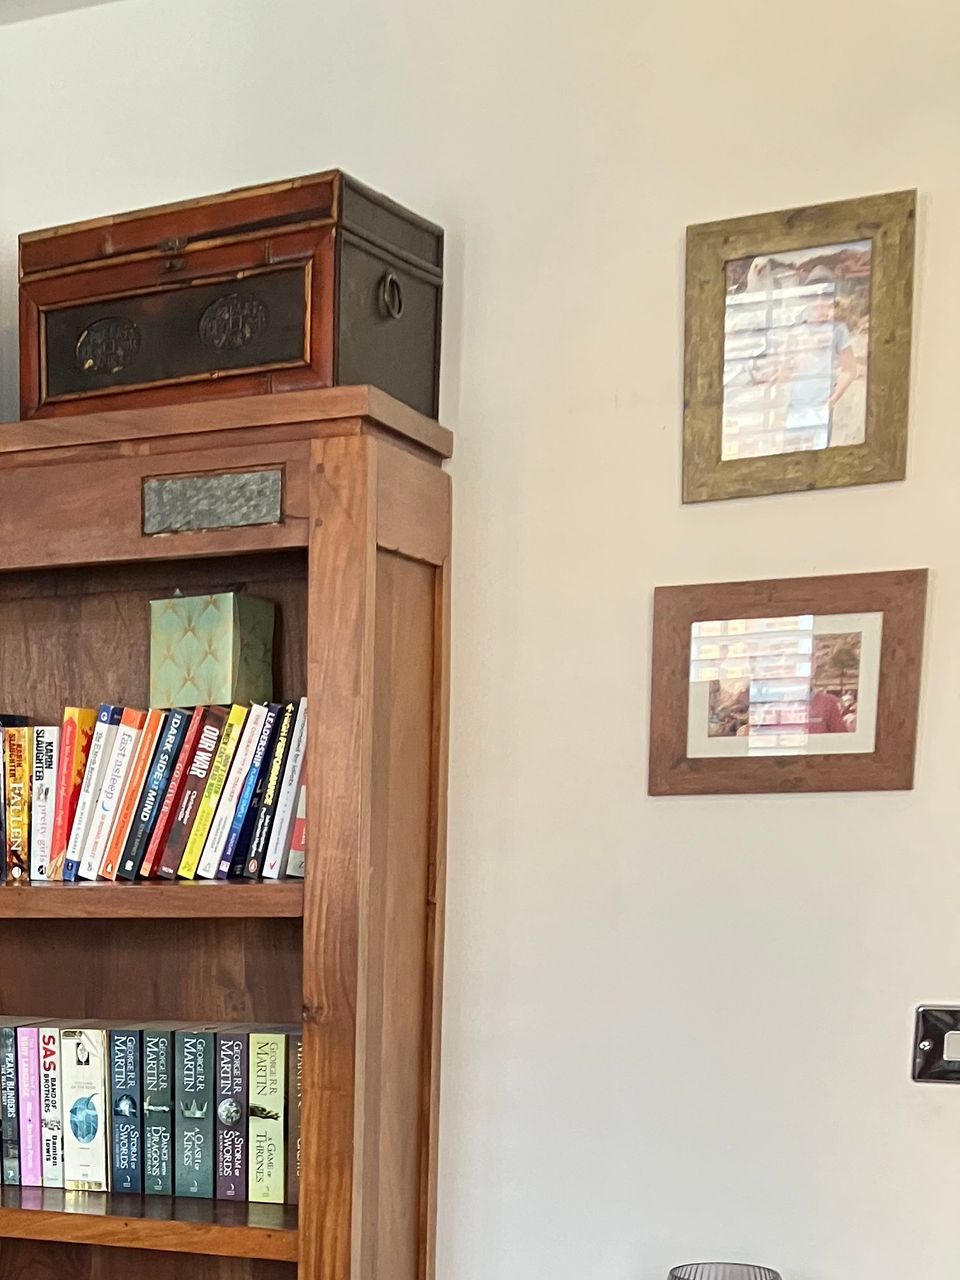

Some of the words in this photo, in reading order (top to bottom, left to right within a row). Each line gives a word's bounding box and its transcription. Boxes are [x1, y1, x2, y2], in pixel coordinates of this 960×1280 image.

[117, 732, 132, 757] fast
[163, 718, 181, 752] DARK
[198, 725, 219, 751] OUR
[223, 723, 234, 745] WOMEN
[252, 712, 275, 767] LEADERSHIP
[36, 729, 44, 781] SLAUGHTER
[45, 742, 53, 769] KARIN
[154, 754, 169, 779] SIDE
[189, 752, 212, 778] WAR
[263, 736, 287, 806] PERFORMANCE
[104, 760, 122, 800] asleep
[288, 765, 298, 787] idiots
[10, 782, 24, 851] FALLEN
[40, 805, 48, 836] pretty
[140, 789, 159, 821] MIND
[38, 840, 48, 862] girls
[5, 1053, 14, 1079] PEAKY
[42, 1034, 56, 1072] SAS
[114, 1035, 127, 1089] MARTIN
[126, 1037, 135, 1071] GEORGE
[146, 1037, 158, 1091] MARTIN
[158, 1038, 167, 1072] GEORGE
[184, 1037, 196, 1093] MARTIN
[196, 1039, 205, 1073] GEORGE
[221, 1040, 233, 1095] MARTIN
[233, 1041, 242, 1076] GEORGE
[256, 1041, 269, 1096] MARTIN
[269, 1042, 278, 1076] GEORGE
[7, 1081, 16, 1118] BLINDERS
[43, 1073, 51, 1113] BROTHERS
[51, 1100, 57, 1110] OF
[120, 1124, 131, 1169] SWORDS
[130, 1130, 138, 1162] STORM
[151, 1127, 162, 1176] DRAGONS
[161, 1132, 169, 1161] DANCE
[183, 1131, 195, 1166] KINGS
[194, 1134, 203, 1163] CLASH
[223, 1130, 235, 1176] SWORDS
[234, 1137, 243, 1168] STORM
[256, 1130, 267, 1183] THRONES
[267, 1143, 276, 1169] GAME
